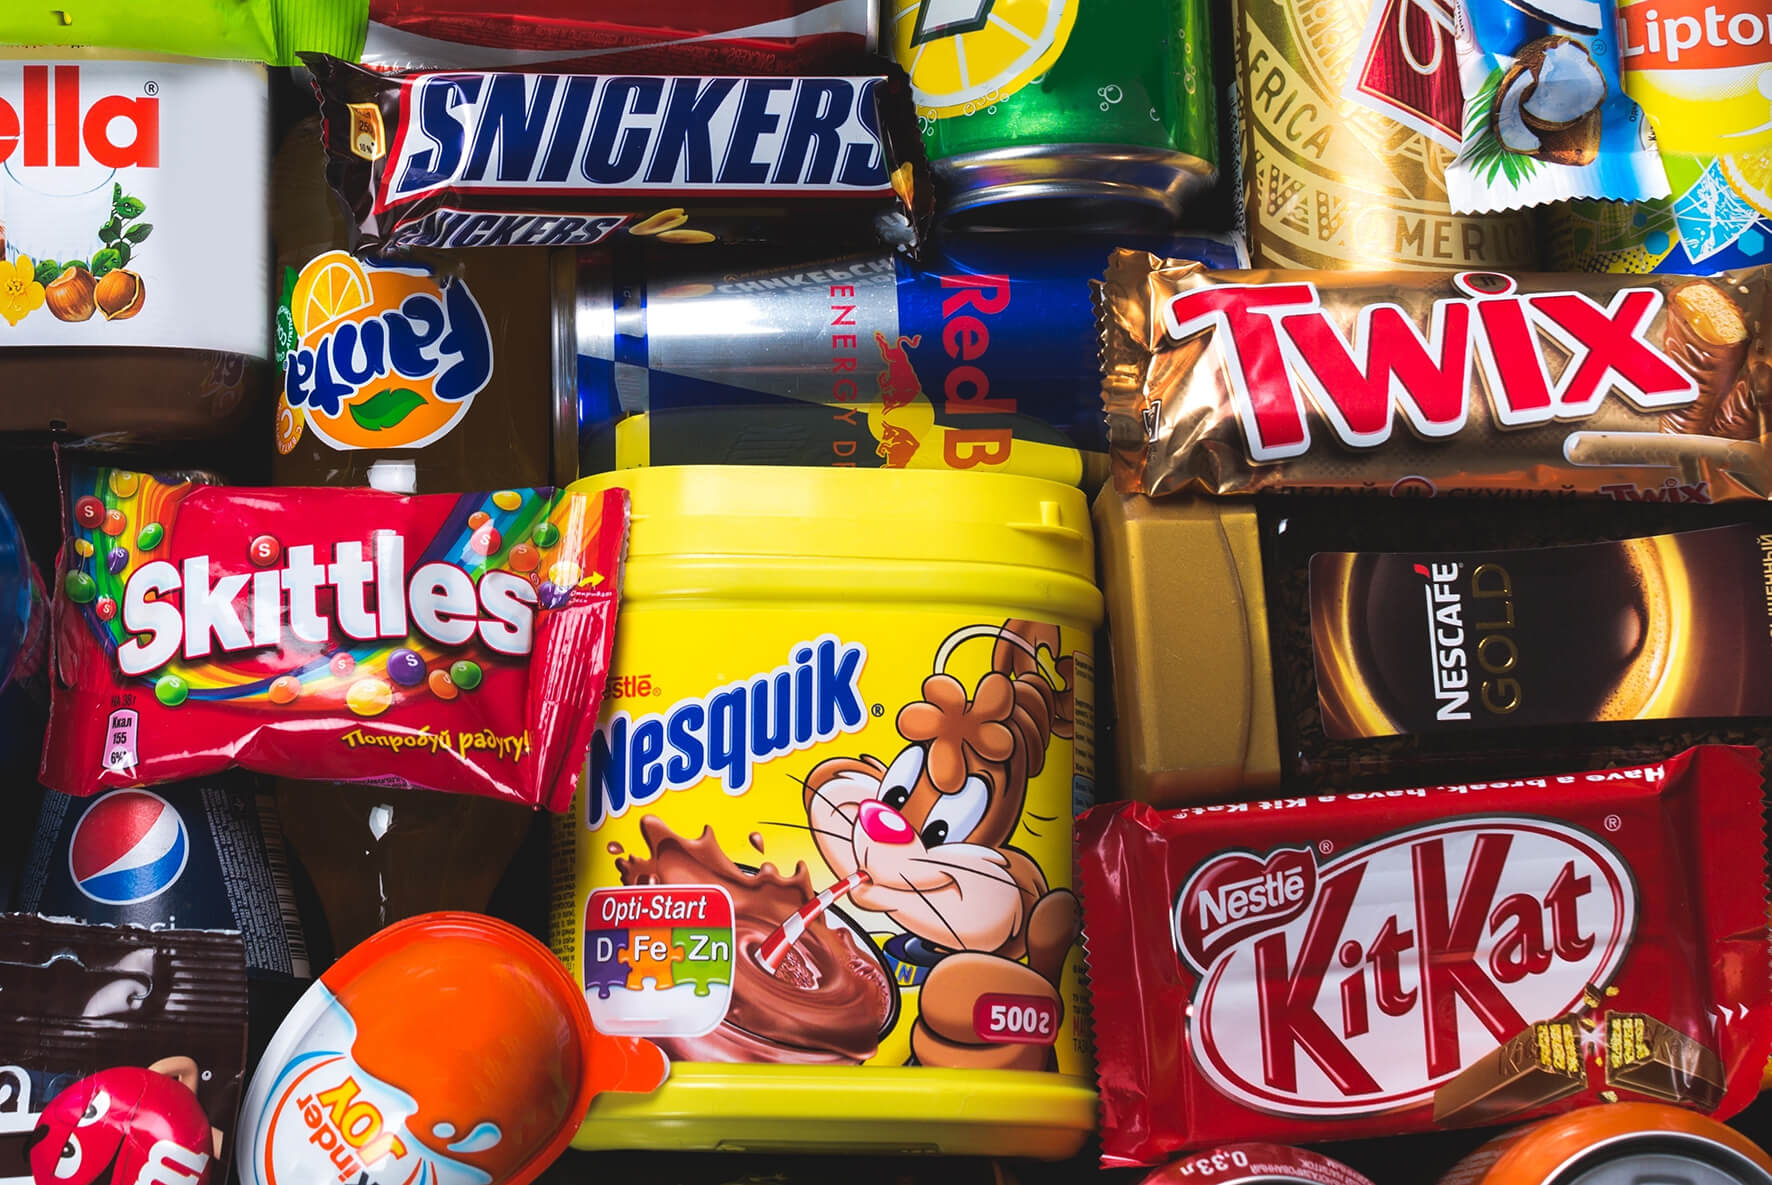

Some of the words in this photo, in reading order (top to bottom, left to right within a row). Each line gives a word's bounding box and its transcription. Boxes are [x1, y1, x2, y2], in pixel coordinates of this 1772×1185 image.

[1621, 5, 1772, 62] Lipto
[0, 65, 159, 168] lla
[394, 74, 890, 194] SNICKERS
[1249, 49, 1334, 160] FRICA
[286, 266, 491, 417] Fanta
[830, 285, 858, 425] ENERGY
[940, 274, 1016, 414] Red
[1171, 273, 1697, 455] Twix
[944, 429, 1012, 470] B
[117, 529, 538, 676] Skittles
[1472, 562, 1521, 715] GOLD
[113, 732, 127, 744] 155
[342, 725, 452, 753] Попробуй
[459, 728, 531, 763] радугу!
[588, 639, 862, 827] Nesquik
[1586, 765, 1665, 782] Have
[1259, 798, 1307, 809] Kit
[1347, 787, 1426, 800] have
[1556, 776, 1575, 784] a
[596, 936, 613, 962] D
[633, 936, 667, 961] Fe
[688, 936, 729, 961] Zn
[601, 895, 706, 925] Opti-Start
[316, 1075, 408, 1168] JOY
